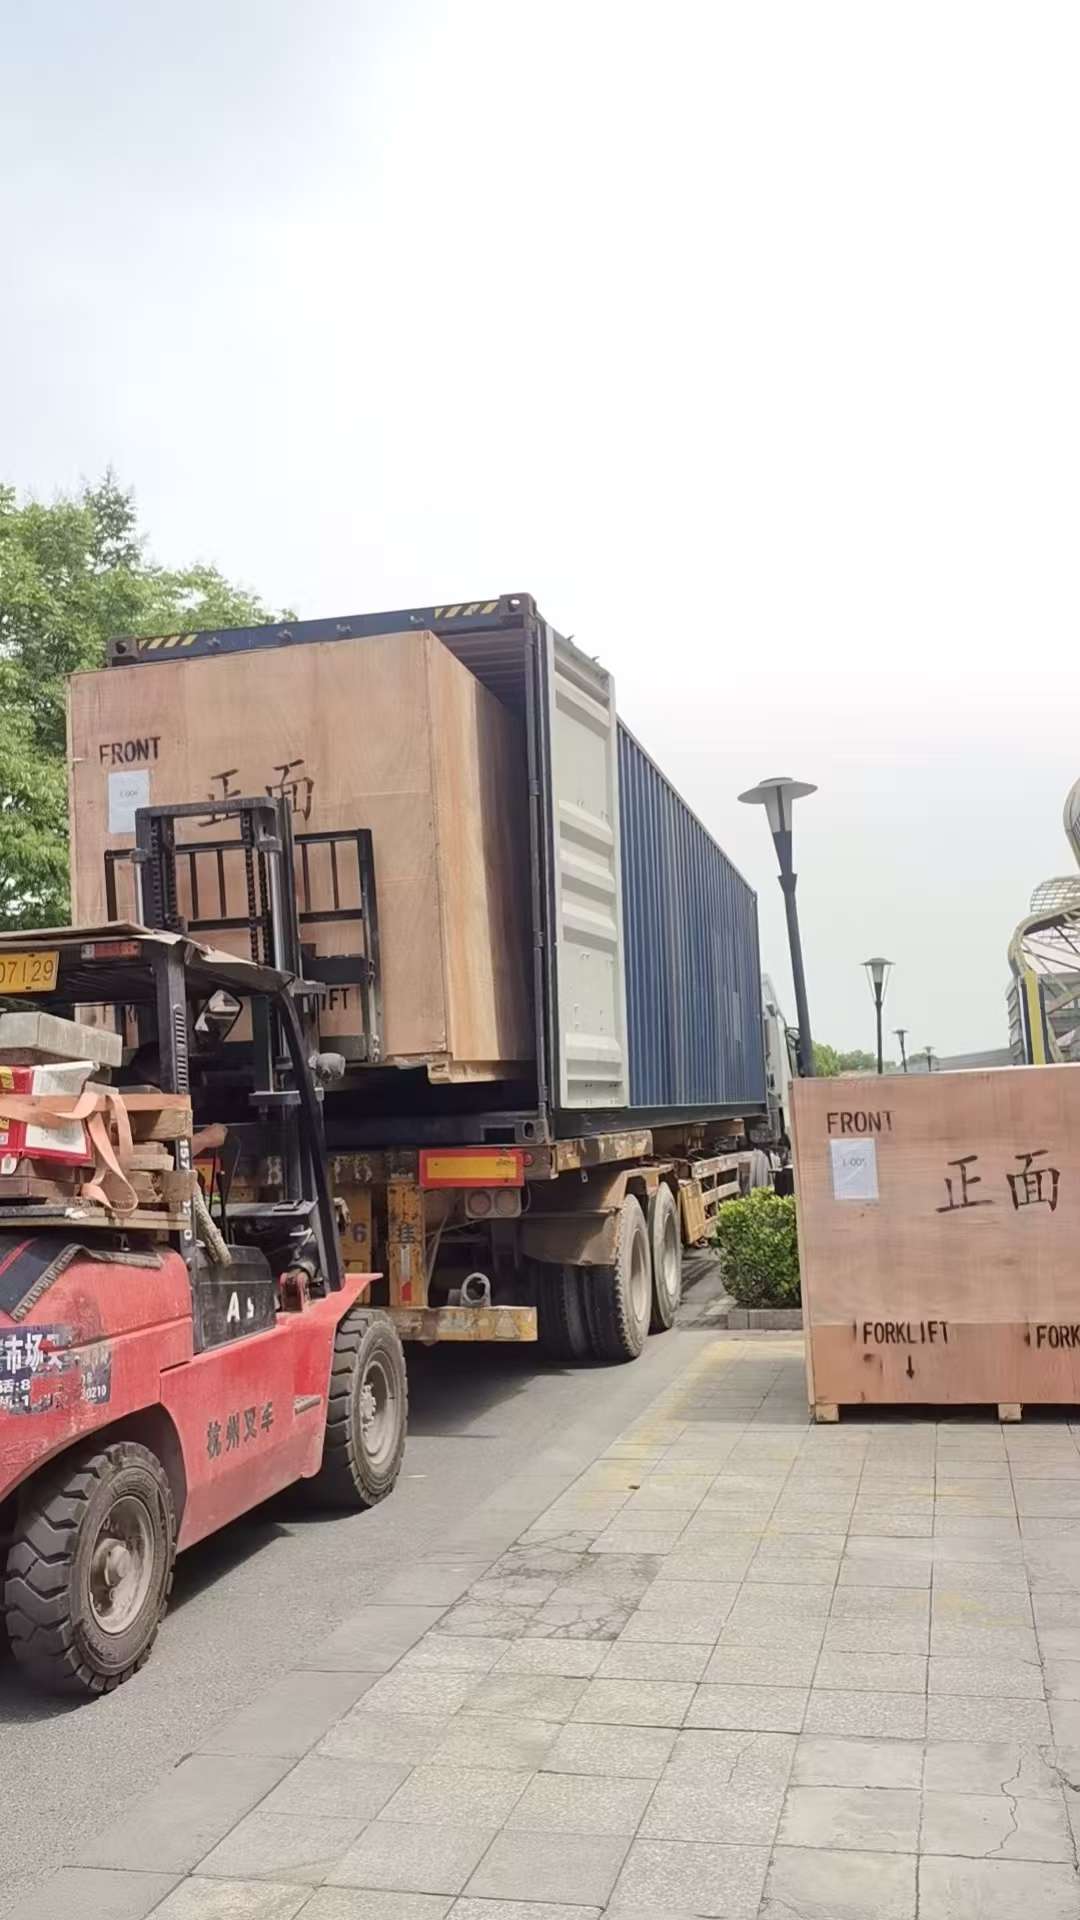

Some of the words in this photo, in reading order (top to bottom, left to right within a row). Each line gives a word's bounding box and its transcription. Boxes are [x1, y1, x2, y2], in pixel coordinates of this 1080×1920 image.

[99, 736, 161, 765] FRONT
[826, 1110, 895, 1134] FRONT
[935, 1149, 1061, 1212] 正面
[862, 1320, 950, 1345] FORKLIFT
[1035, 1324, 1080, 1349] FORK
[206, 1401, 274, 1460] 杭州叉车
